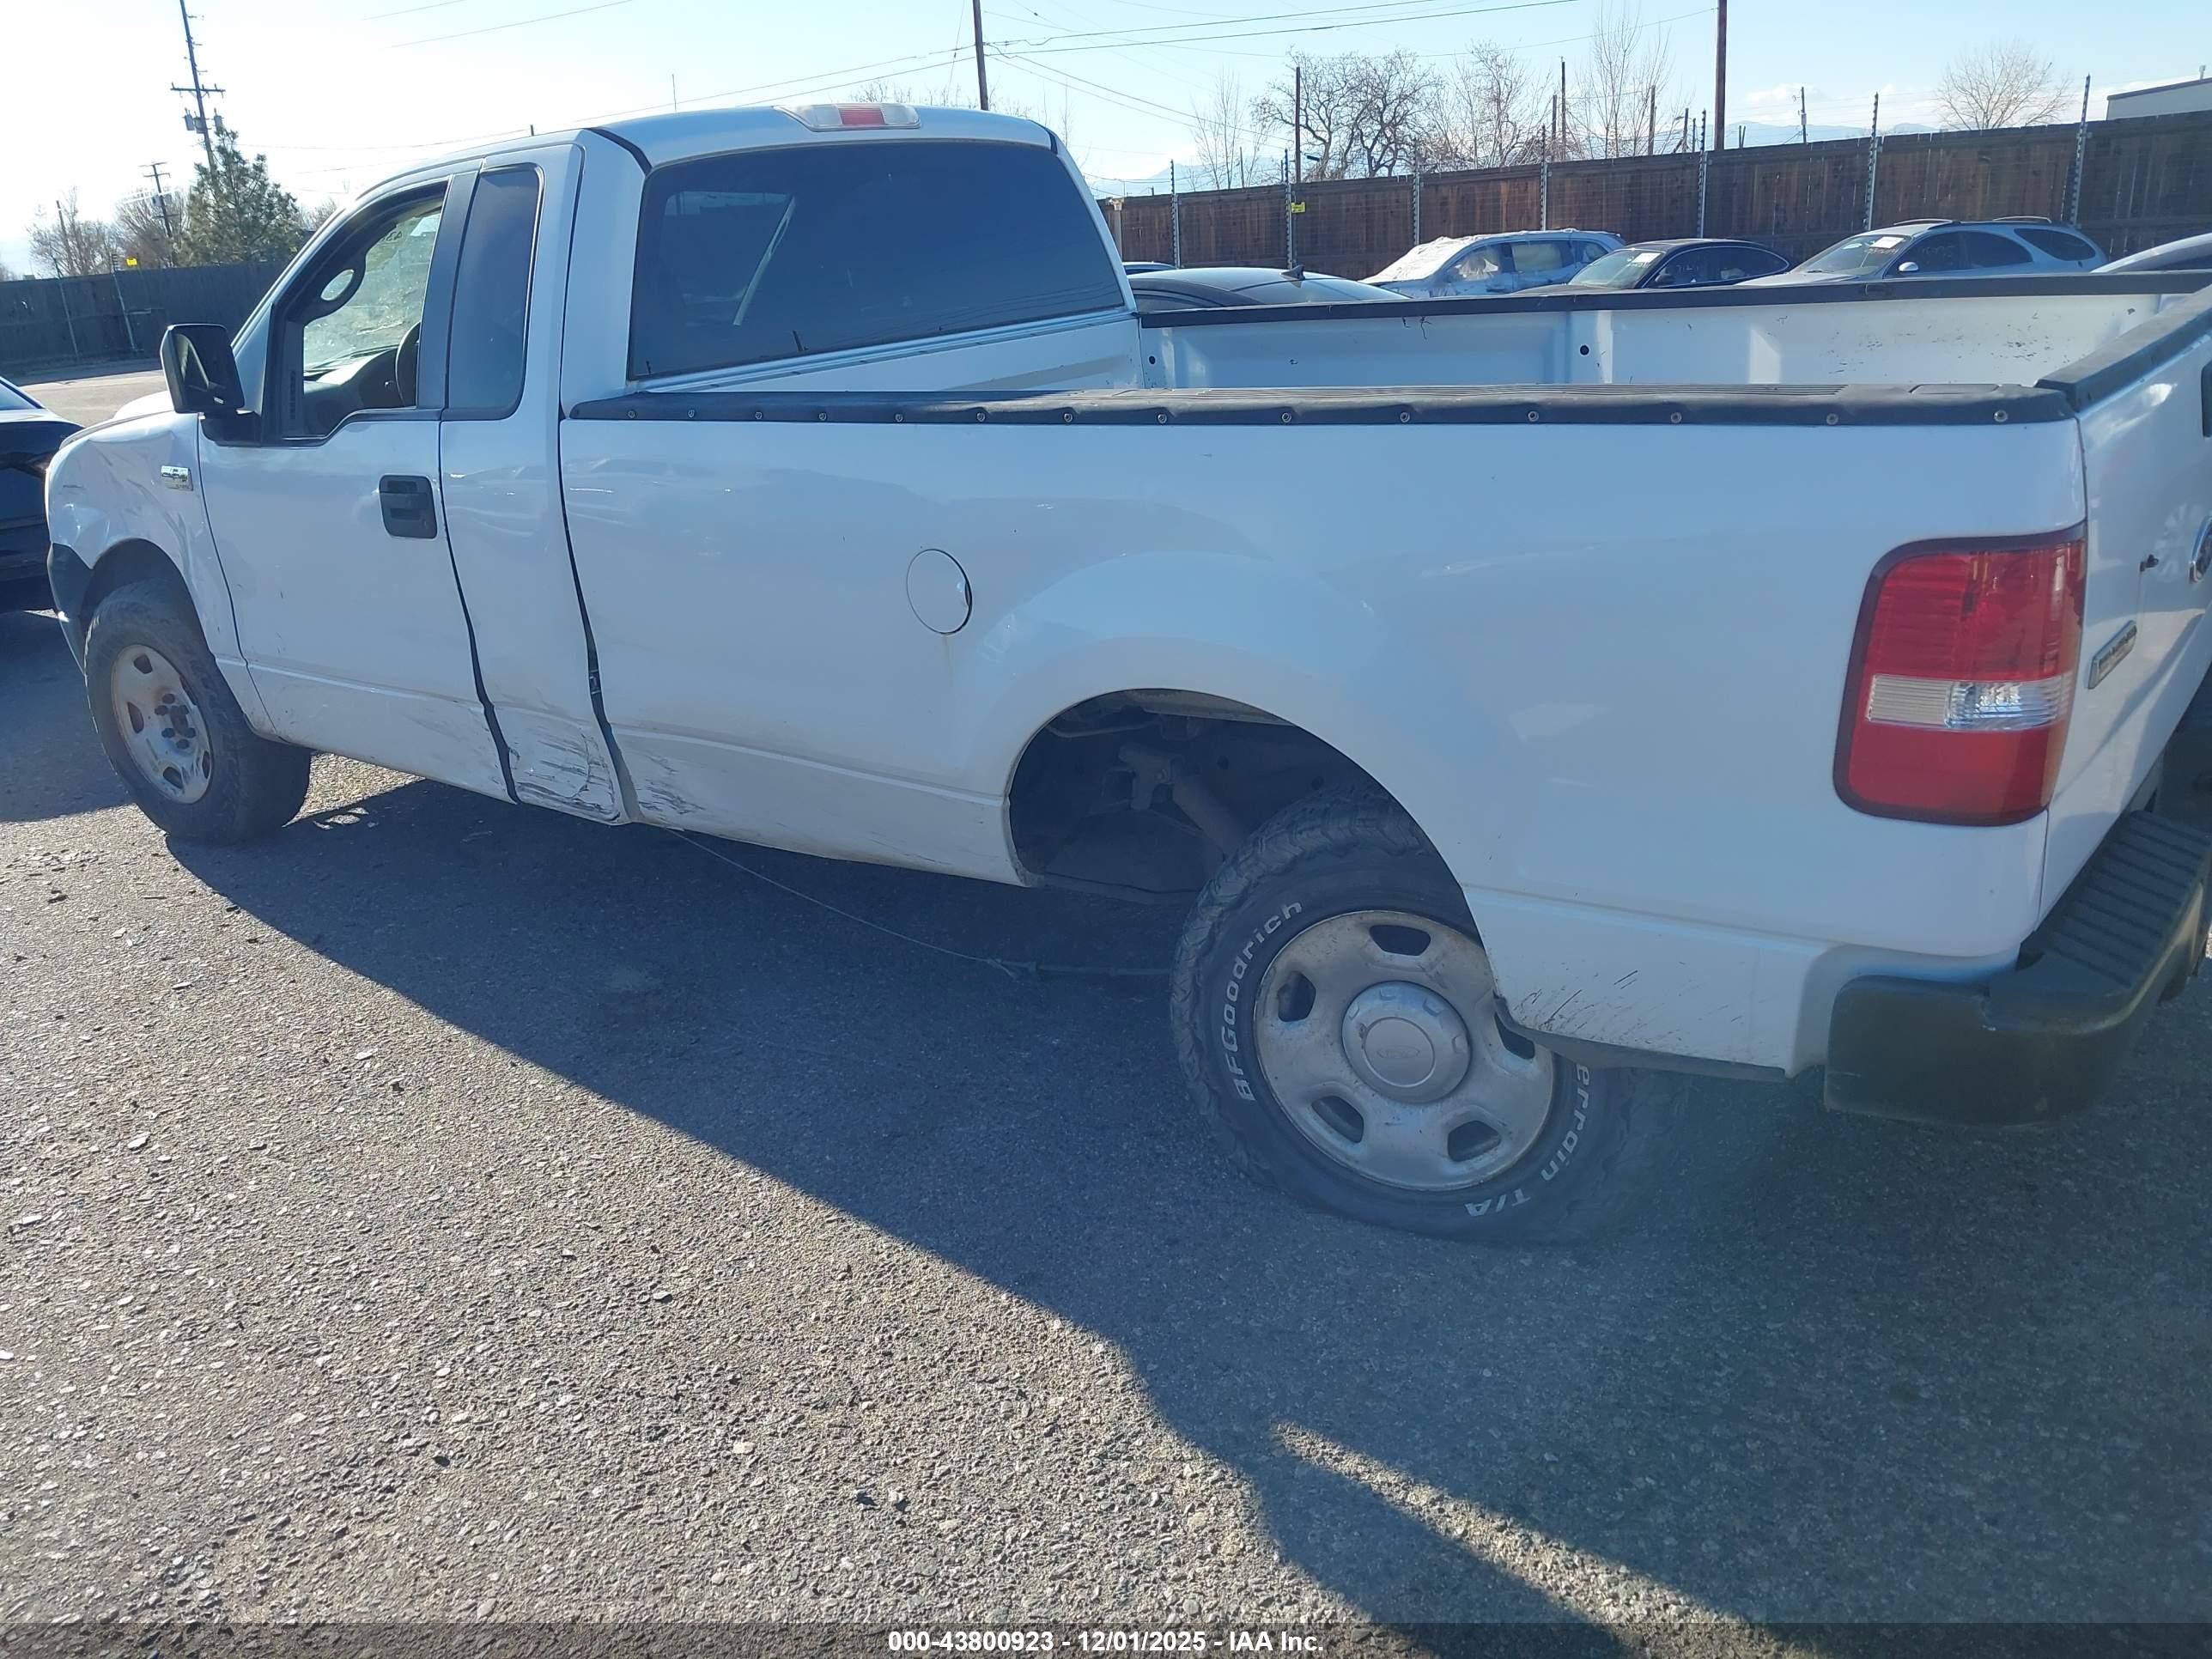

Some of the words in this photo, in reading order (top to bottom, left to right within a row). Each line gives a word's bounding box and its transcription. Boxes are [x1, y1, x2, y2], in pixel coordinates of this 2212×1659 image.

[1221, 902, 1303, 1102] BFGoodrich
[1540, 1063, 1590, 1182] errain
[1463, 1188, 1532, 1217] T/A
